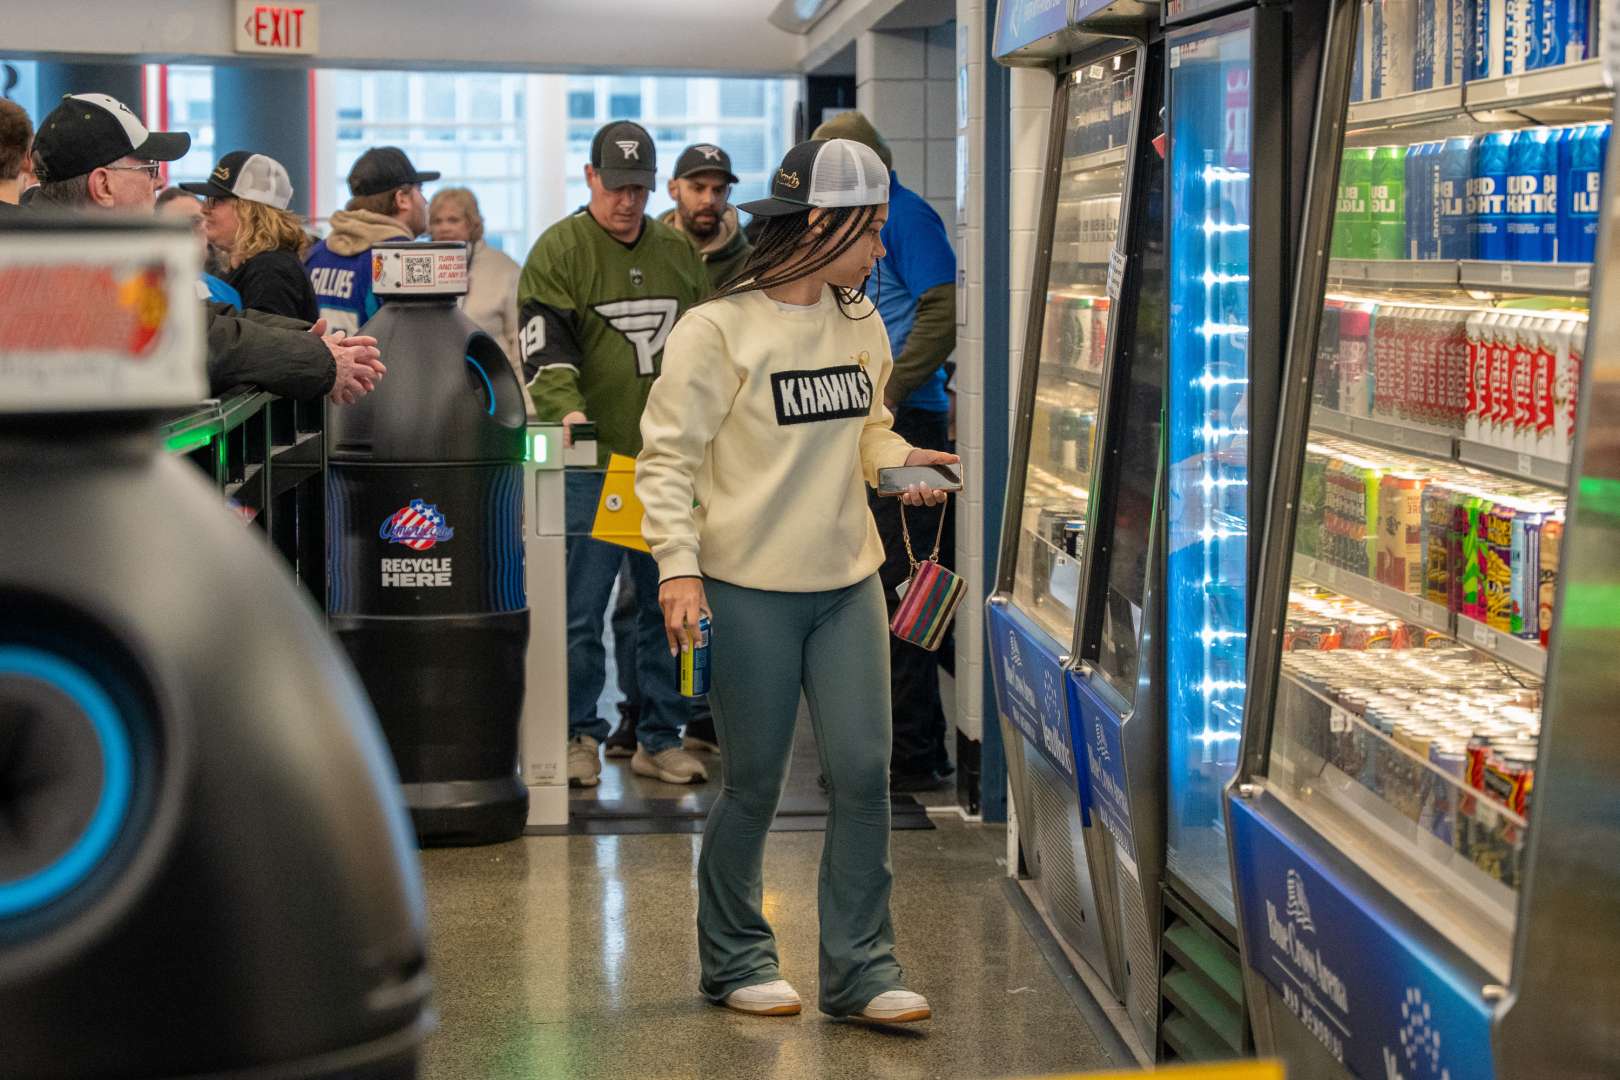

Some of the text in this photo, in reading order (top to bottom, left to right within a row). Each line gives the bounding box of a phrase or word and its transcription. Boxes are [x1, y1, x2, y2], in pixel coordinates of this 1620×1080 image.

[255, 6, 304, 48] EXIT
[1537, 354, 1548, 424] STELLA
[381, 558, 452, 572] RECYCLE
[381, 572, 452, 587] HERE
